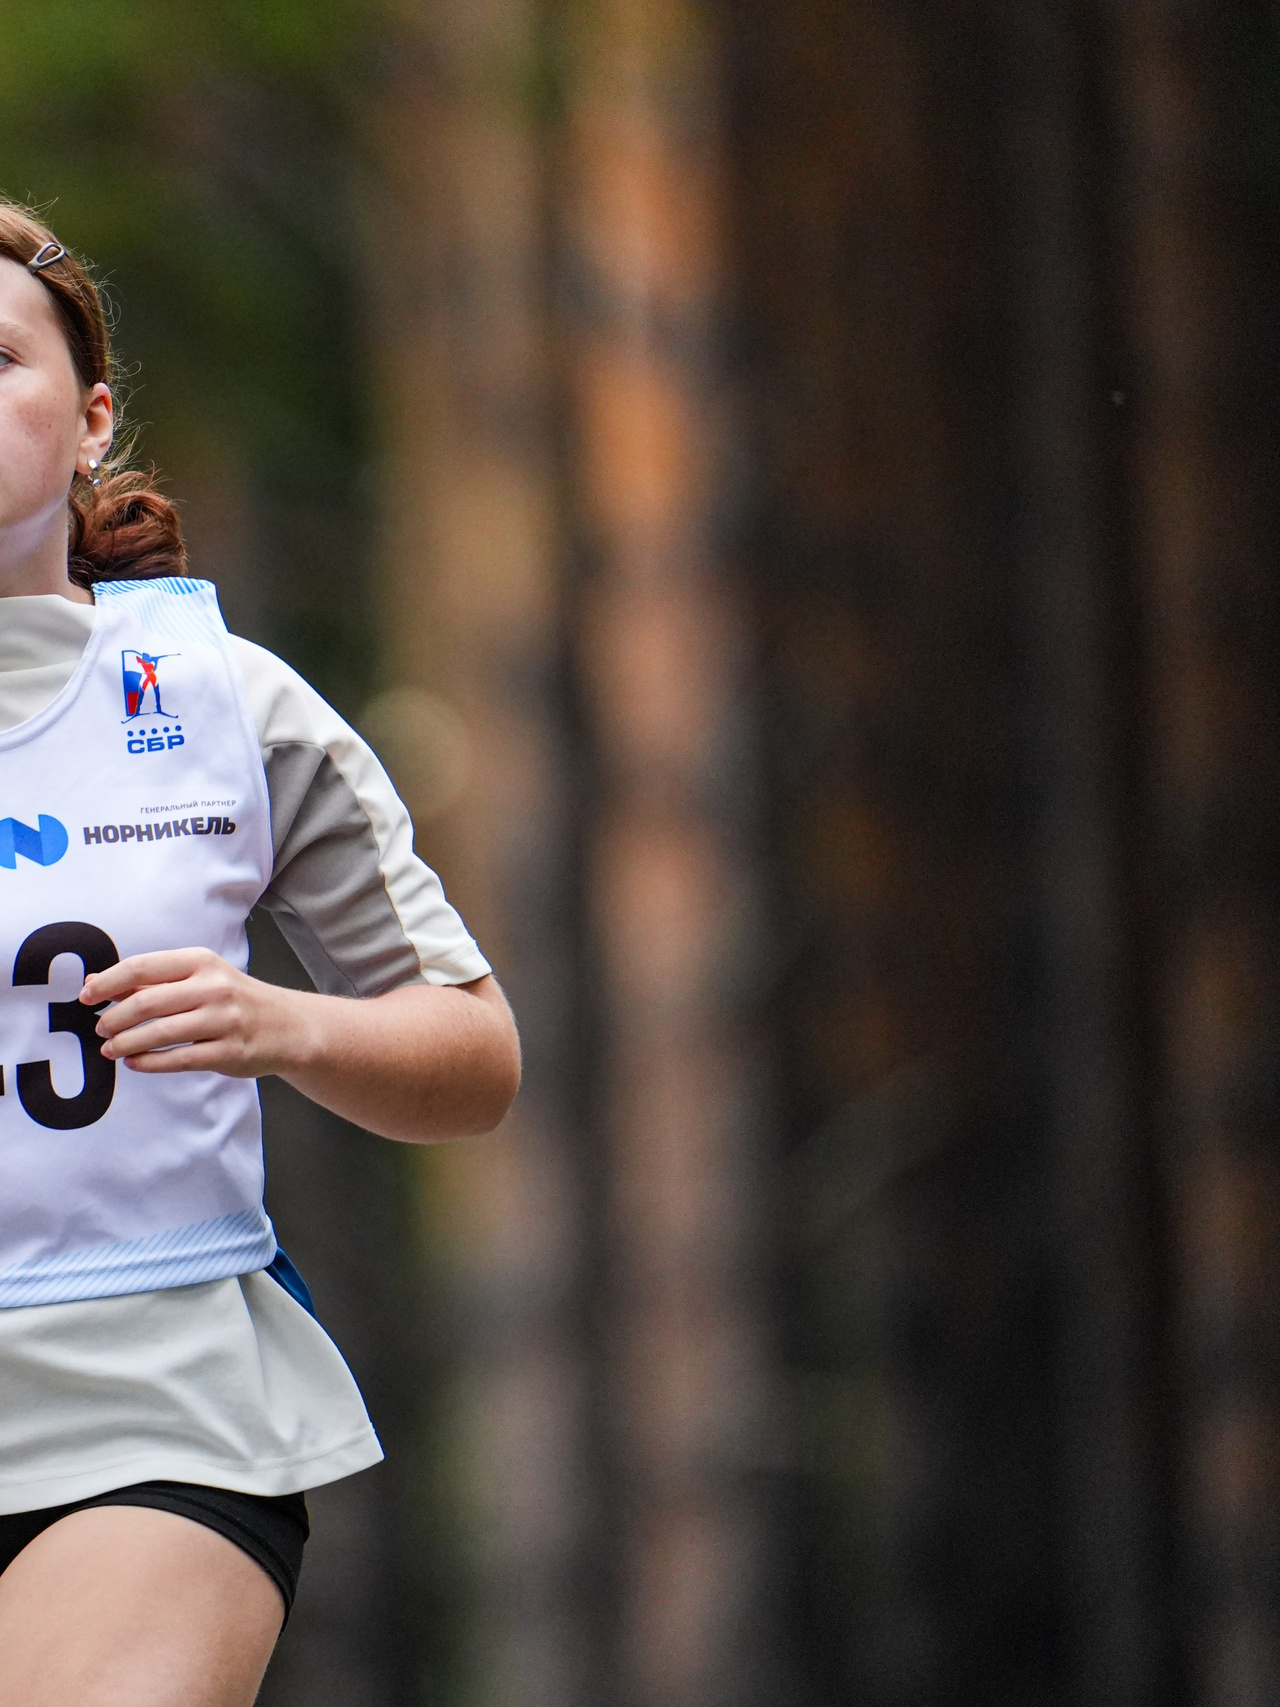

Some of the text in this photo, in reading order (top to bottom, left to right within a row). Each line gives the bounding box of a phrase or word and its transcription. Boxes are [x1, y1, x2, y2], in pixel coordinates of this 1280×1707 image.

[127, 734, 185, 754] СБР
[140, 800, 237, 814] ГЕНЕРАЛЬНЫЙ ПАРТНЕР
[83, 816, 237, 845] НОРНИКЕЛЬ
